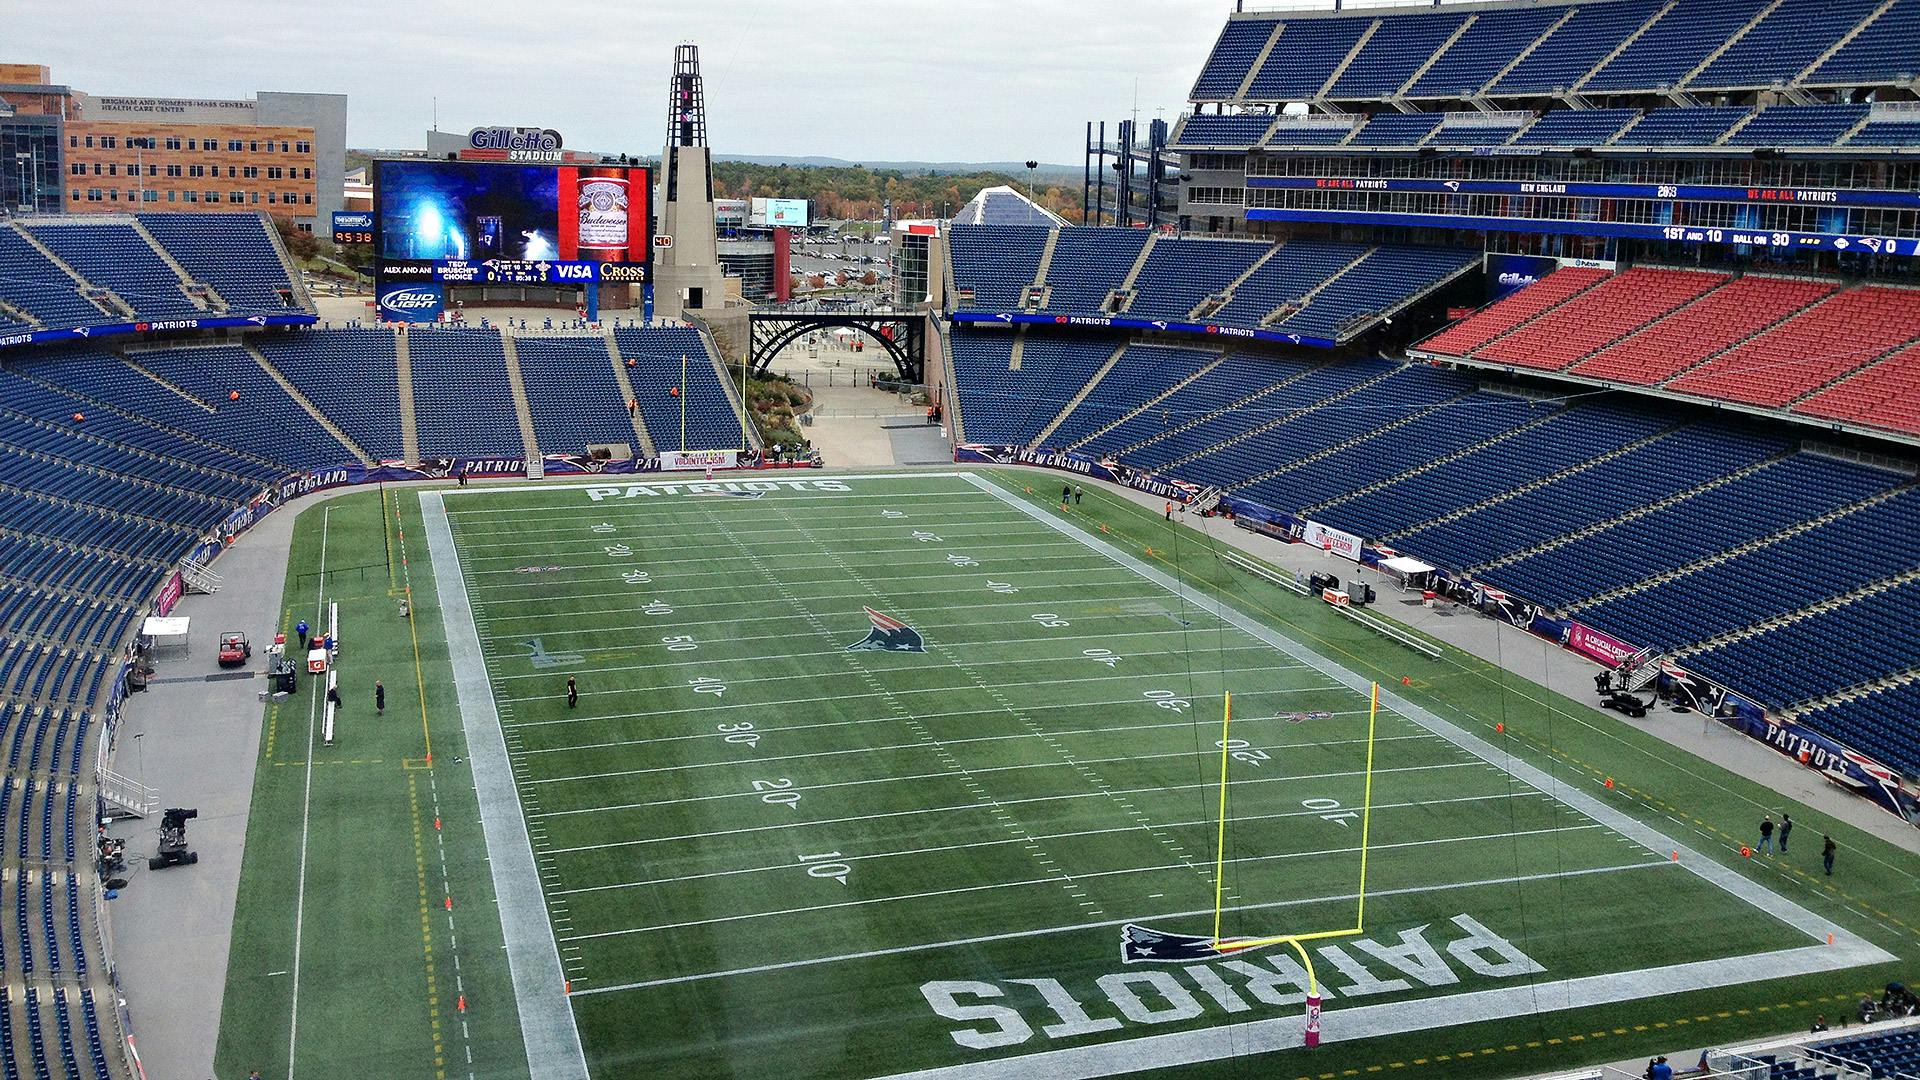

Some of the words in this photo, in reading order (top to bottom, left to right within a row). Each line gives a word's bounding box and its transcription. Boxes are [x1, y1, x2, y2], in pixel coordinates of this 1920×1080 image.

[101, 99, 138, 107] BRIGHAM
[139, 99, 156, 107] AND
[219, 102, 254, 110] GENERAL
[472, 129, 554, 150] Gillette
[510, 150, 563, 161] STADIUM
[1316, 179, 1326, 188] WE
[1328, 179, 1340, 188] ARE
[1355, 180, 1388, 189] PATRIOTS
[1521, 183, 1536, 193] NEW
[1537, 184, 1566, 194] ENGLAND
[1748, 189, 1759, 199] WE
[1761, 190, 1777, 200] ARE
[1778, 190, 1794, 201] ALL
[1797, 191, 1837, 202] PATRIOTS
[580, 212, 627, 225] Budweiser
[655, 236, 670, 246] 40
[1663, 228, 1685, 240] 1ST
[1687, 232, 1703, 241] AND
[1706, 230, 1722, 242] 10
[1733, 234, 1753, 244] BALL
[1754, 235, 1767, 245] ON
[1772, 233, 1789, 246] 30
[1886, 240, 1896, 253] 0
[383, 266, 401, 274] ALEX
[402, 266, 418, 274] AND
[419, 266, 432, 274] ANI
[1581, 259, 1600, 268] Putnam
[487, 271, 495, 281] 0
[539, 271, 547, 281] 3
[555, 264, 593, 279] VISA
[390, 300, 438, 308] LIGHT
[397, 293, 435, 301] BUD
[135, 322, 149, 332] GO
[152, 319, 198, 331] PATRIOTS
[1055, 316, 1068, 324] GO
[1070, 316, 1111, 326] PATRIOTS
[1206, 325, 1218, 333] GO
[1219, 326, 1255, 337] PATRIOTS
[1018, 450, 1045, 465] NEW
[1046, 454, 1091, 474] ENGLAND
[283, 482, 297, 498] NEW
[298, 470, 348, 492] ENGLAND
[584, 480, 853, 501] PATRIOTS
[1134, 477, 1179, 499] PATRIOTS
[622, 571, 652, 584] 30
[1031, 613, 1070, 628] 50
[662, 635, 698, 651] 50
[1584, 633, 1591, 642] A
[1590, 635, 1612, 652] CRUCIAL
[1083, 648, 1122, 663] 40
[313, 661, 321, 669] G
[688, 676, 728, 693] 40
[1143, 690, 1191, 710] 30
[717, 722, 761, 743] 30
[1215, 739, 1272, 762] 20
[1765, 723, 1849, 776] PATRIOTS
[751, 778, 802, 804] 20
[1301, 798, 1359, 821] 10
[797, 851, 852, 878] 10
[919, 913, 1548, 1050] PATRIOTS
